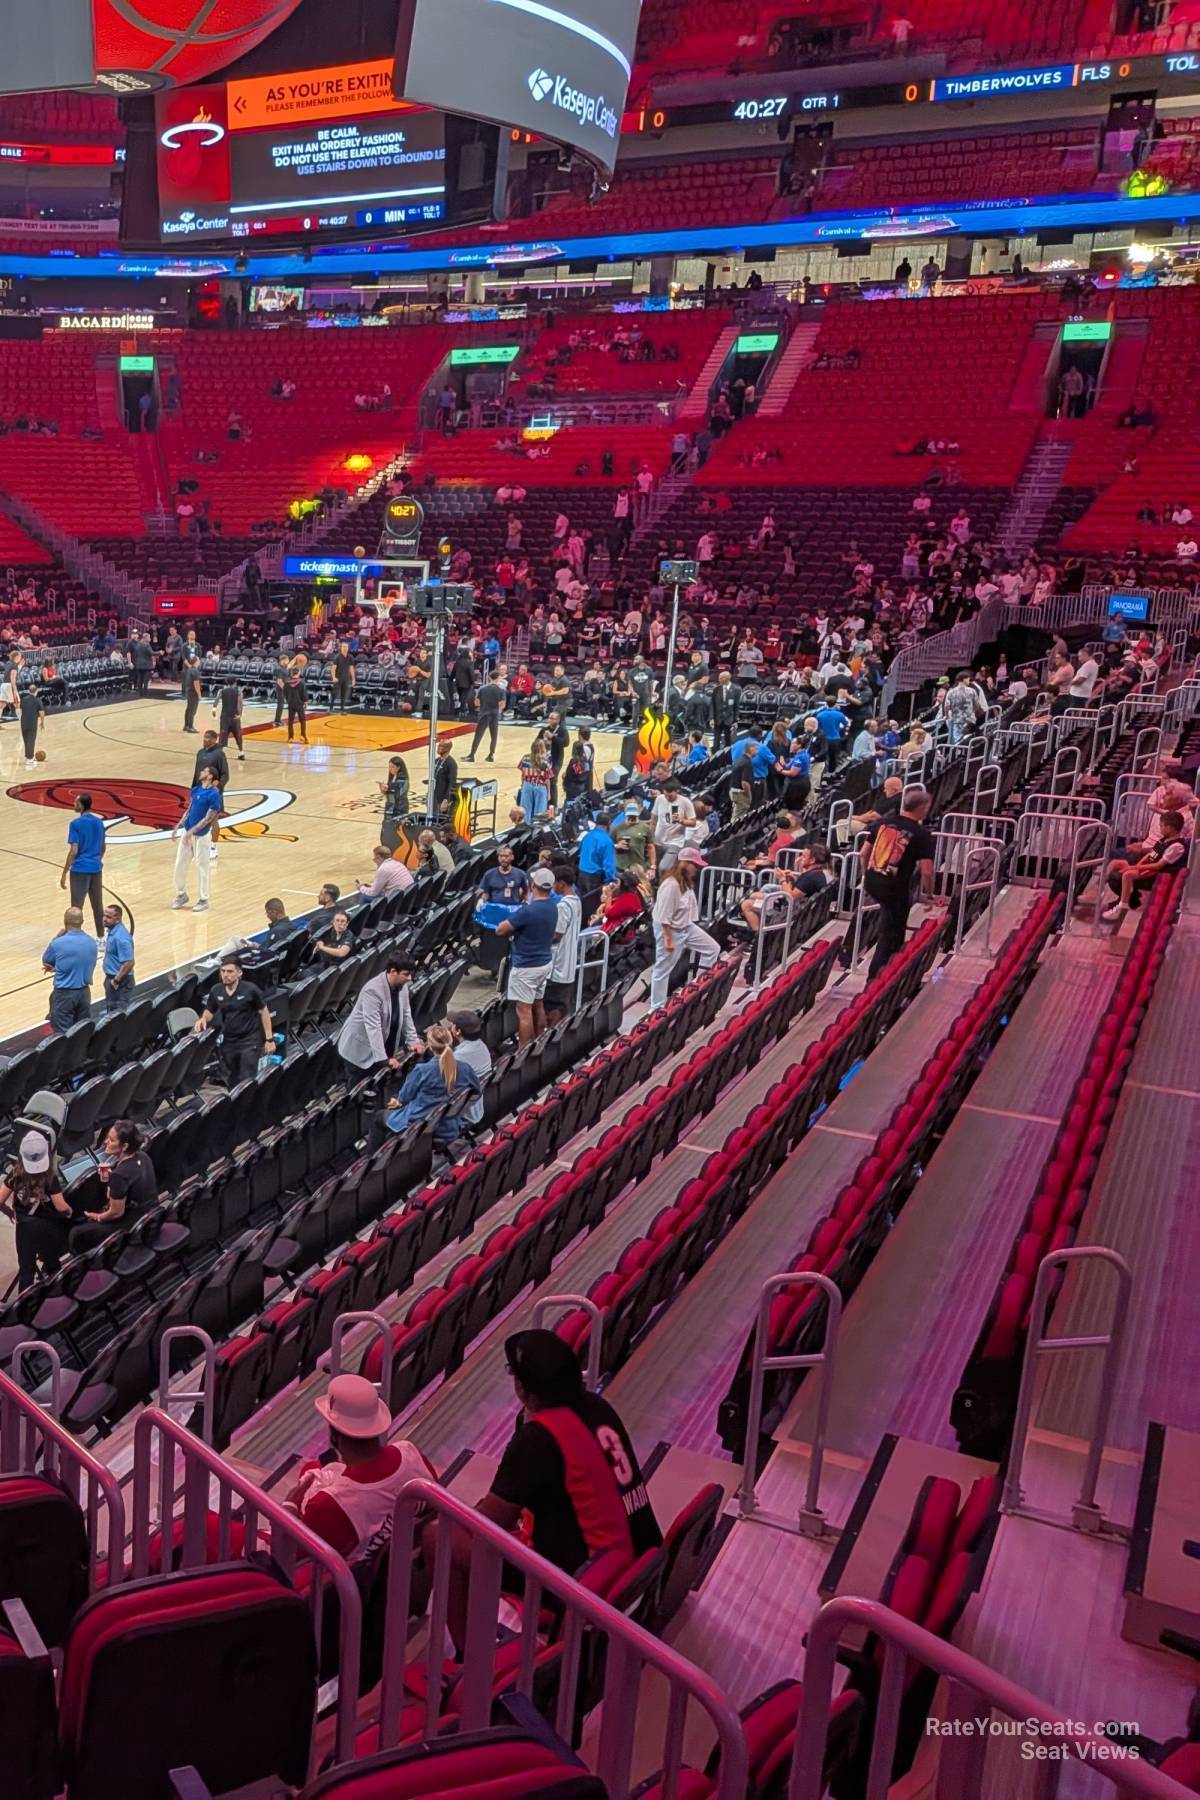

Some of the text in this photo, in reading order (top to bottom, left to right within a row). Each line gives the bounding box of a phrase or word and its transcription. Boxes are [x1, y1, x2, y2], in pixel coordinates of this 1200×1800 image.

[266, 86, 285, 102] AS
[287, 78, 343, 100] YOU'RE
[734, 56, 1199, 119] 40:27 QTR 1 0 TIMBERWOLVES FLS 0 TOL
[265, 101, 295, 113] PLEASE
[295, 96, 340, 110] REMEMBER
[340, 93, 355, 105] THE
[553, 75, 618, 138] Kaseya Center
[654, 111, 664, 127] 0
[318, 126, 359, 140] BE CALM.
[272, 132, 405, 157] EXIT IN AN ORDERLY FASHION.
[275, 143, 403, 167] DO NOT USE THE ELEVATORS.
[297, 163, 315, 175] USE
[316, 159, 346, 173] STAIRS
[347, 156, 378, 170] DOWN
[379, 153, 392, 166] TO
[393, 150, 432, 165] GROUND
[163, 222, 195, 234] Kaseya
[196, 218, 228, 230] Center
[304, 218, 311, 229] 0
[365, 212, 372, 224] 0
[385, 210, 405, 223] MIN
[391, 505, 416, 516] 40:27
[597, 1425, 632, 1485] 3
